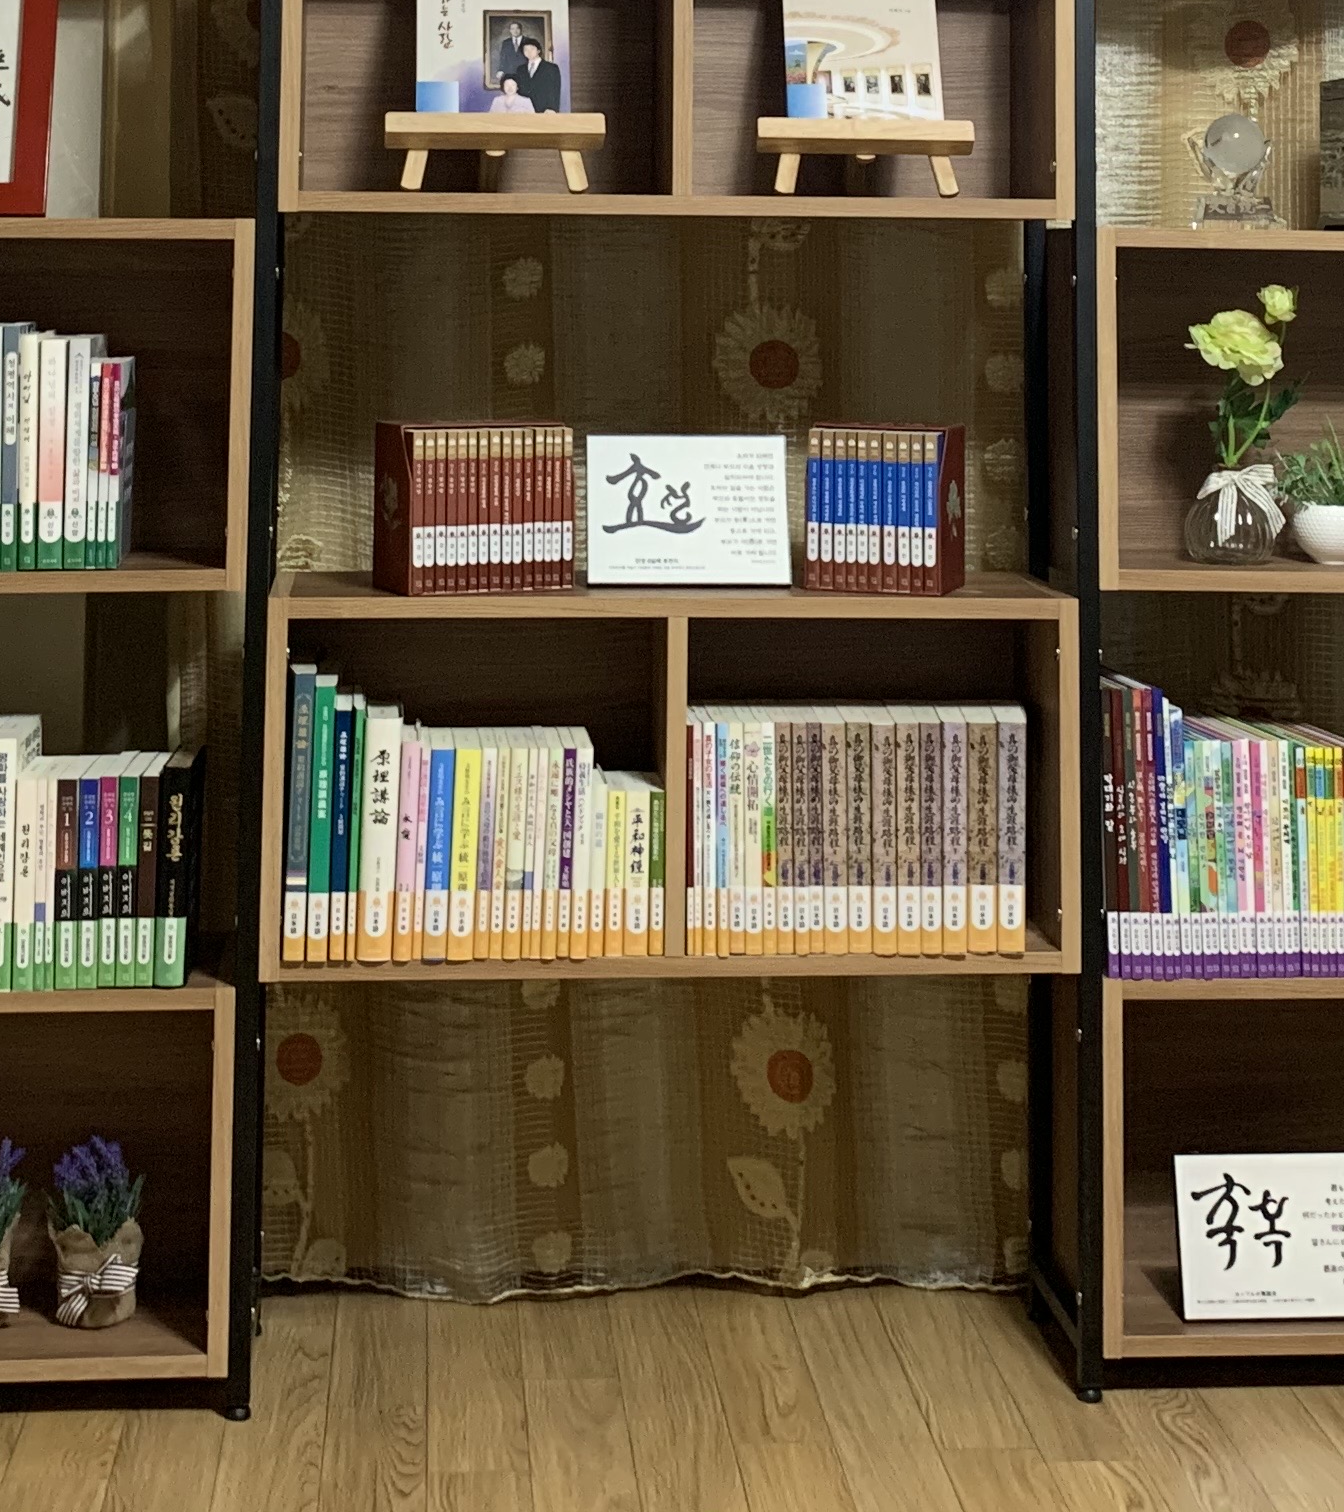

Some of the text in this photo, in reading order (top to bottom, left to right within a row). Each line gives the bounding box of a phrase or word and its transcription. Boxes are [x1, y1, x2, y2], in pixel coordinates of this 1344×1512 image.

[728, 738, 742, 796] 信仰の伝統
[369, 749, 391, 826] 原理講論
[746, 760, 759, 812] 心情開拓
[64, 812, 71, 827] 1
[84, 810, 94, 826] 2
[105, 809, 113, 825] 3
[123, 808, 133, 823] 4
[372, 911, 380, 933] 日本語
[633, 908, 641, 930] 日本語
[1190, 1172, 1290, 1271] 축복
